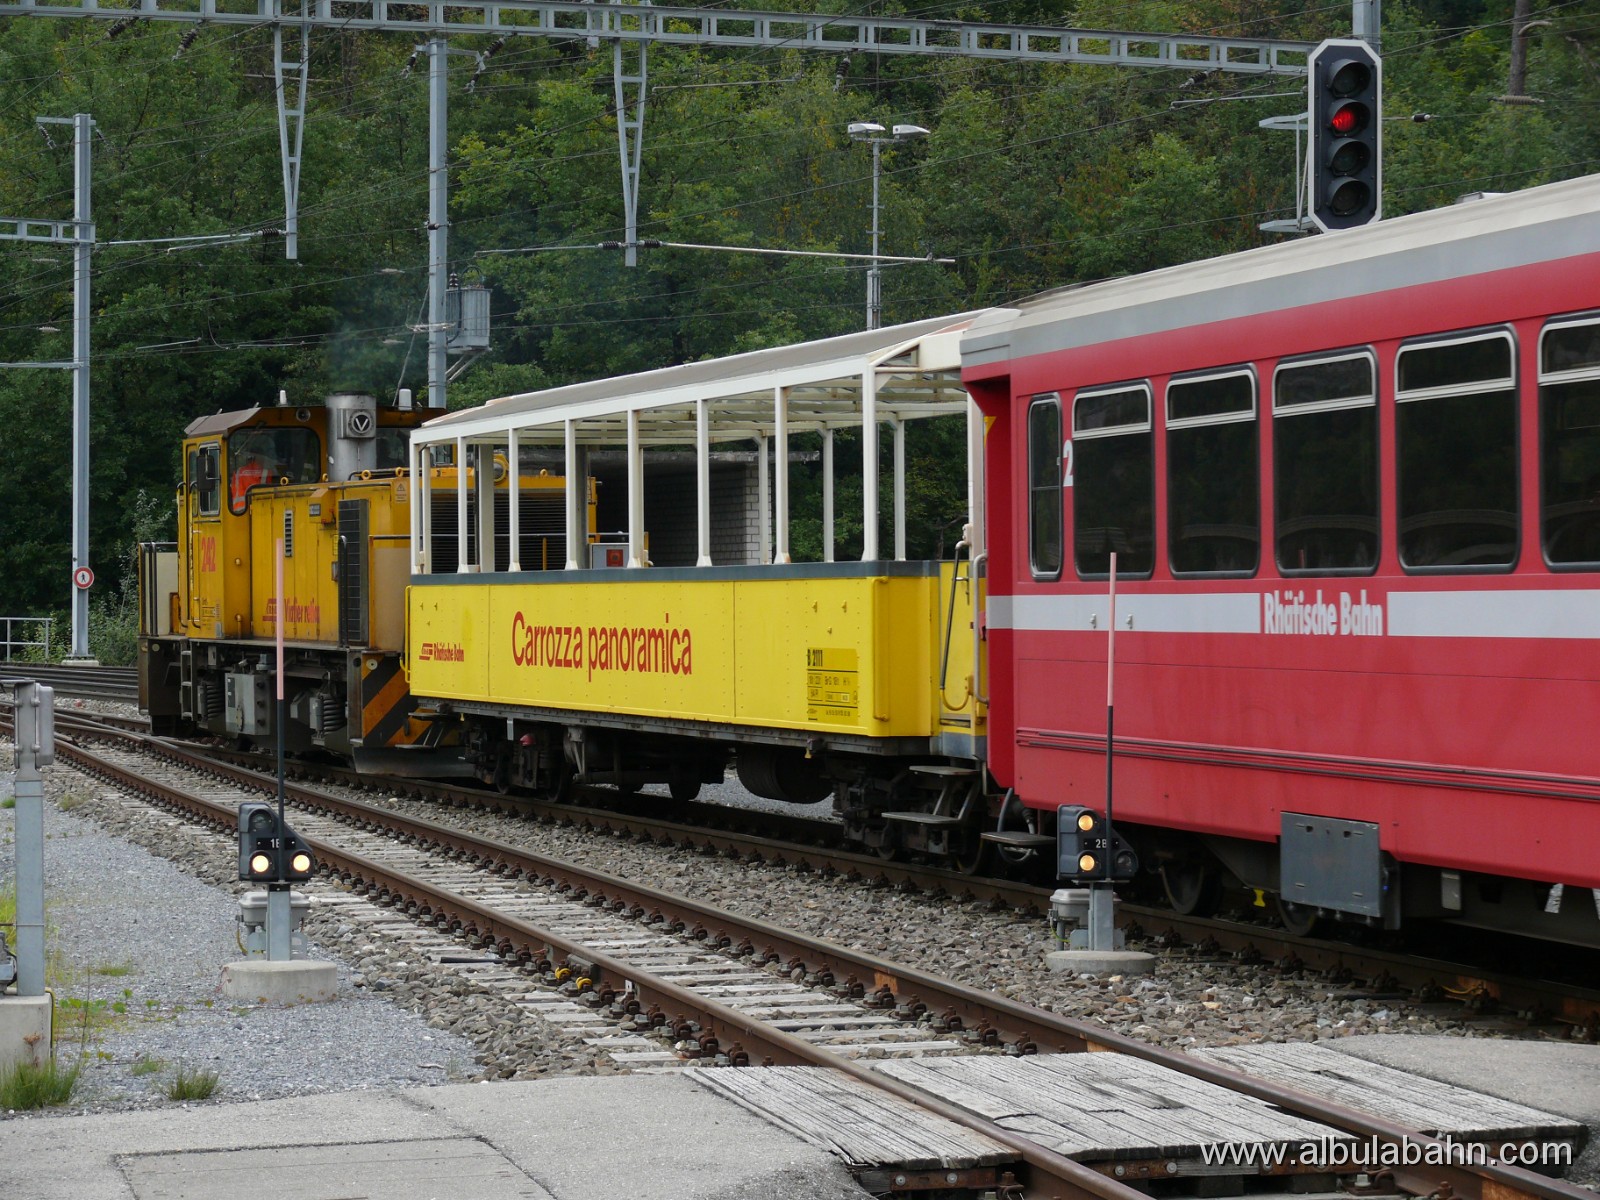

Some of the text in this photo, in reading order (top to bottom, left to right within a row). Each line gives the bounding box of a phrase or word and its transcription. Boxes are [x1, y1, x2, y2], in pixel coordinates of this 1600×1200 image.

[1062, 439, 1074, 487] 2
[201, 536, 216, 572] 242
[1264, 589, 1383, 636] Rhätische Bahn
[454, 642, 464, 662] Bahn
[511, 610, 693, 682] Carrozza panoramica
